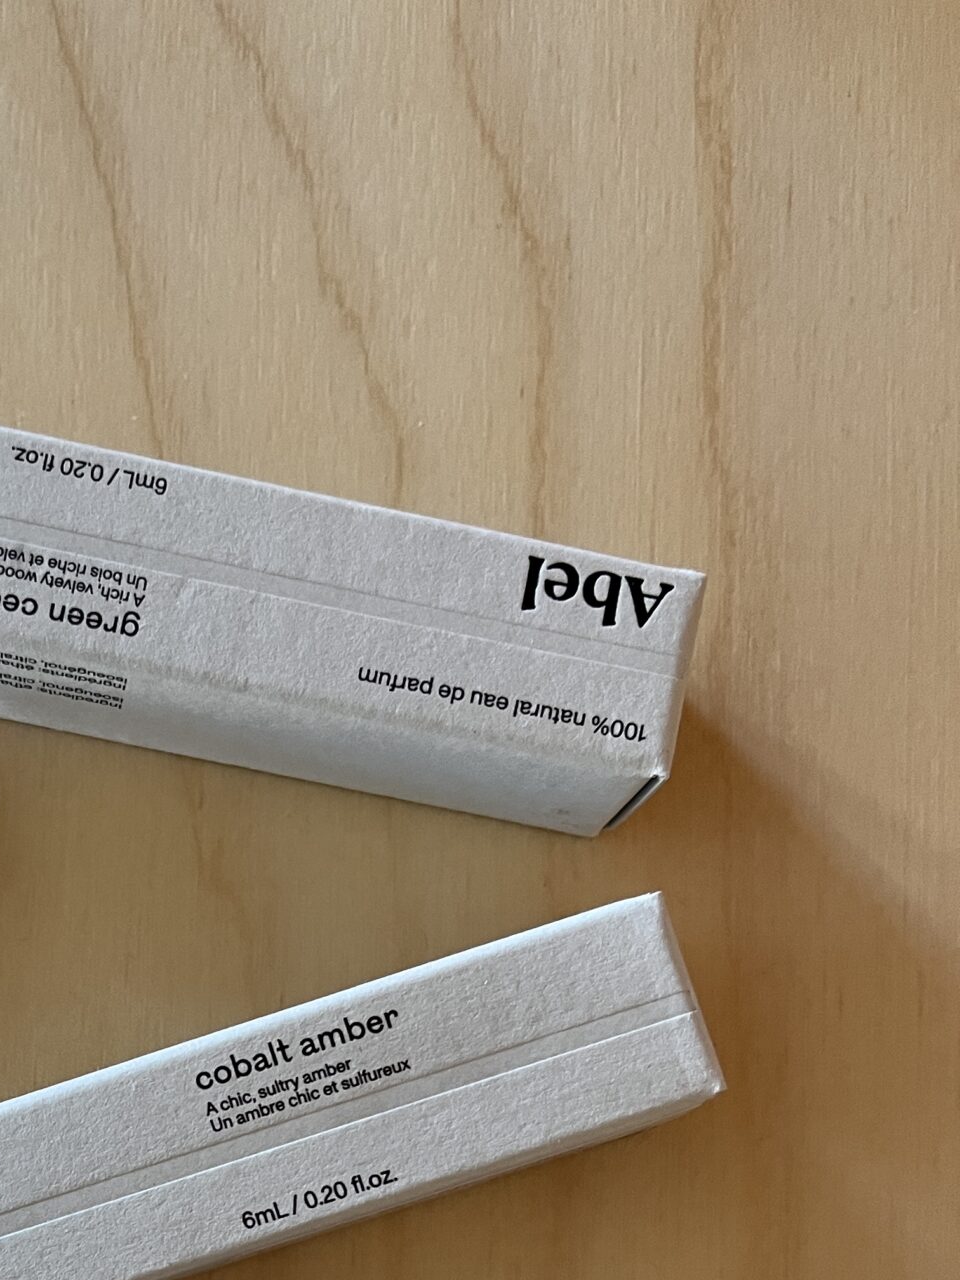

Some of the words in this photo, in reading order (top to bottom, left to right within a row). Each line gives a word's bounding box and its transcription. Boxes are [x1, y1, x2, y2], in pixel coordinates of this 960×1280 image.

[11, 446, 55, 472] fl.oz.
[60, 458, 104, 482] 0.20
[123, 469, 168, 495] 6mL
[30, 553, 44, 566] et
[48, 557, 87, 575] riche
[40, 572, 94, 595] velvety
[90, 567, 122, 583] bois
[127, 576, 148, 591] Un
[98, 585, 130, 604] rich,
[133, 594, 146, 607] A
[521, 555, 675, 629] Abel
[49, 603, 141, 637] green
[358, 667, 434, 695] parfum
[439, 684, 464, 704] de
[470, 689, 508, 710] eau
[513, 699, 586, 726] natural
[591, 715, 647, 742] 100%
[195, 1038, 293, 1090] cobalt
[299, 1008, 399, 1057] amber
[205, 1101, 220, 1116] A
[219, 1089, 257, 1113] chic,
[258, 1073, 300, 1100] sultry
[302, 1059, 353, 1085] amber
[210, 1115, 234, 1133] Un
[236, 1099, 286, 1125] ambre
[288, 1087, 321, 1109] chic
[322, 1080, 340, 1096] et
[340, 1059, 412, 1091] sulfureux
[241, 1201, 290, 1230] 6mL
[304, 1181, 348, 1209] 0.20
[351, 1168, 399, 1195] fl.oz.
